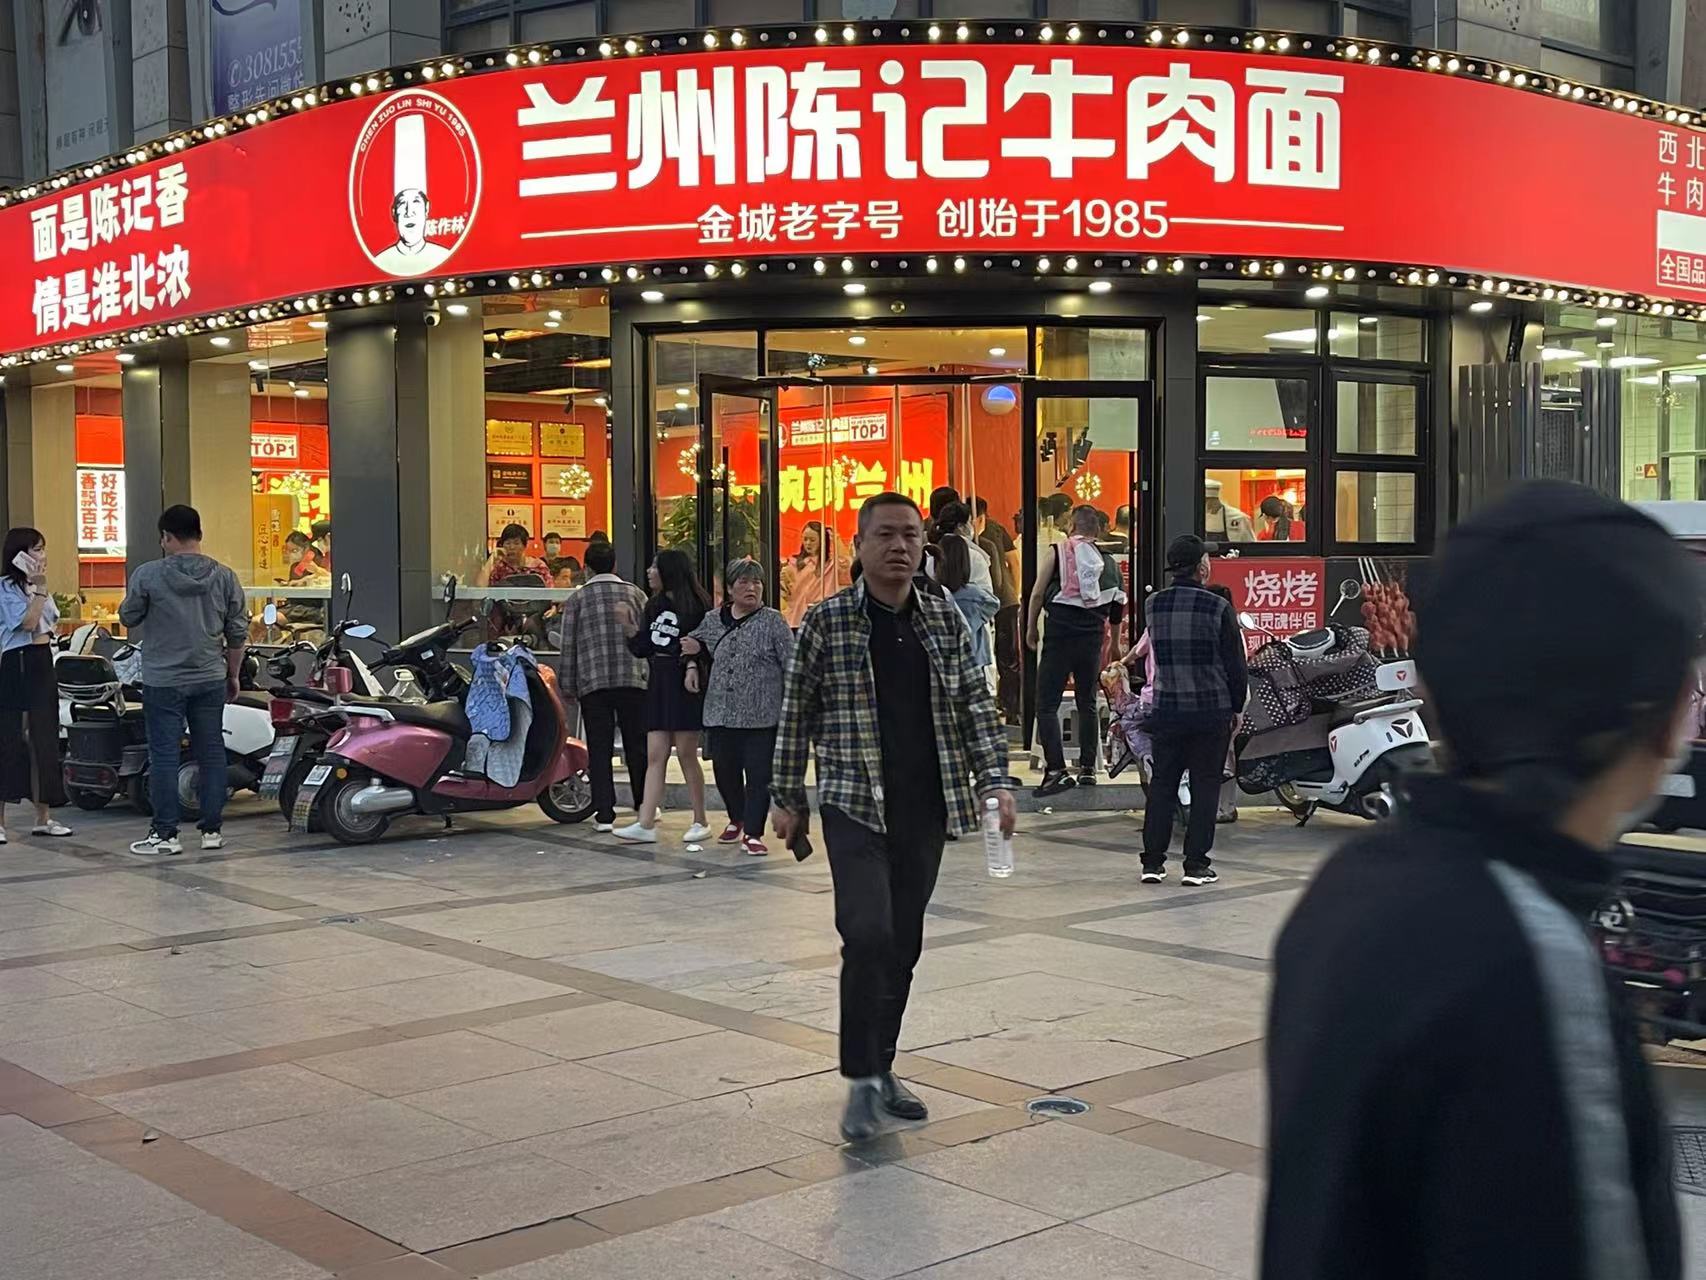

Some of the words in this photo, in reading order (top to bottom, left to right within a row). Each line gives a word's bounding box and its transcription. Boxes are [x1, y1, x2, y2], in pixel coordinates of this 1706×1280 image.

[360, 121, 379, 152] CHEN
[378, 105, 395, 123] ZUO
[397, 98, 412, 110] LIN
[416, 98, 432, 109] SHI
[434, 102, 447, 116] YU
[448, 113, 466, 137] 1985
[518, 59, 1345, 198] 兰州陈记牛肉面
[1658, 130, 1706, 170] 西北
[31, 162, 189, 262] 面是陈记香
[1658, 171, 1704, 211] 牛肉
[424, 215, 466, 237] 陈作林
[697, 200, 904, 243] 金城老字号
[937, 198, 1168, 238] 创始于1985
[32, 244, 191, 335] 情是淮北浓
[1661, 254, 1706, 284] 全国品
[251, 442, 295, 456] TOP1
[851, 424, 885, 439] TOP1
[81, 472, 98, 542] 香飘百年
[101, 472, 118, 542] 好吃不贵
[1244, 570, 1318, 607] 烧烤
